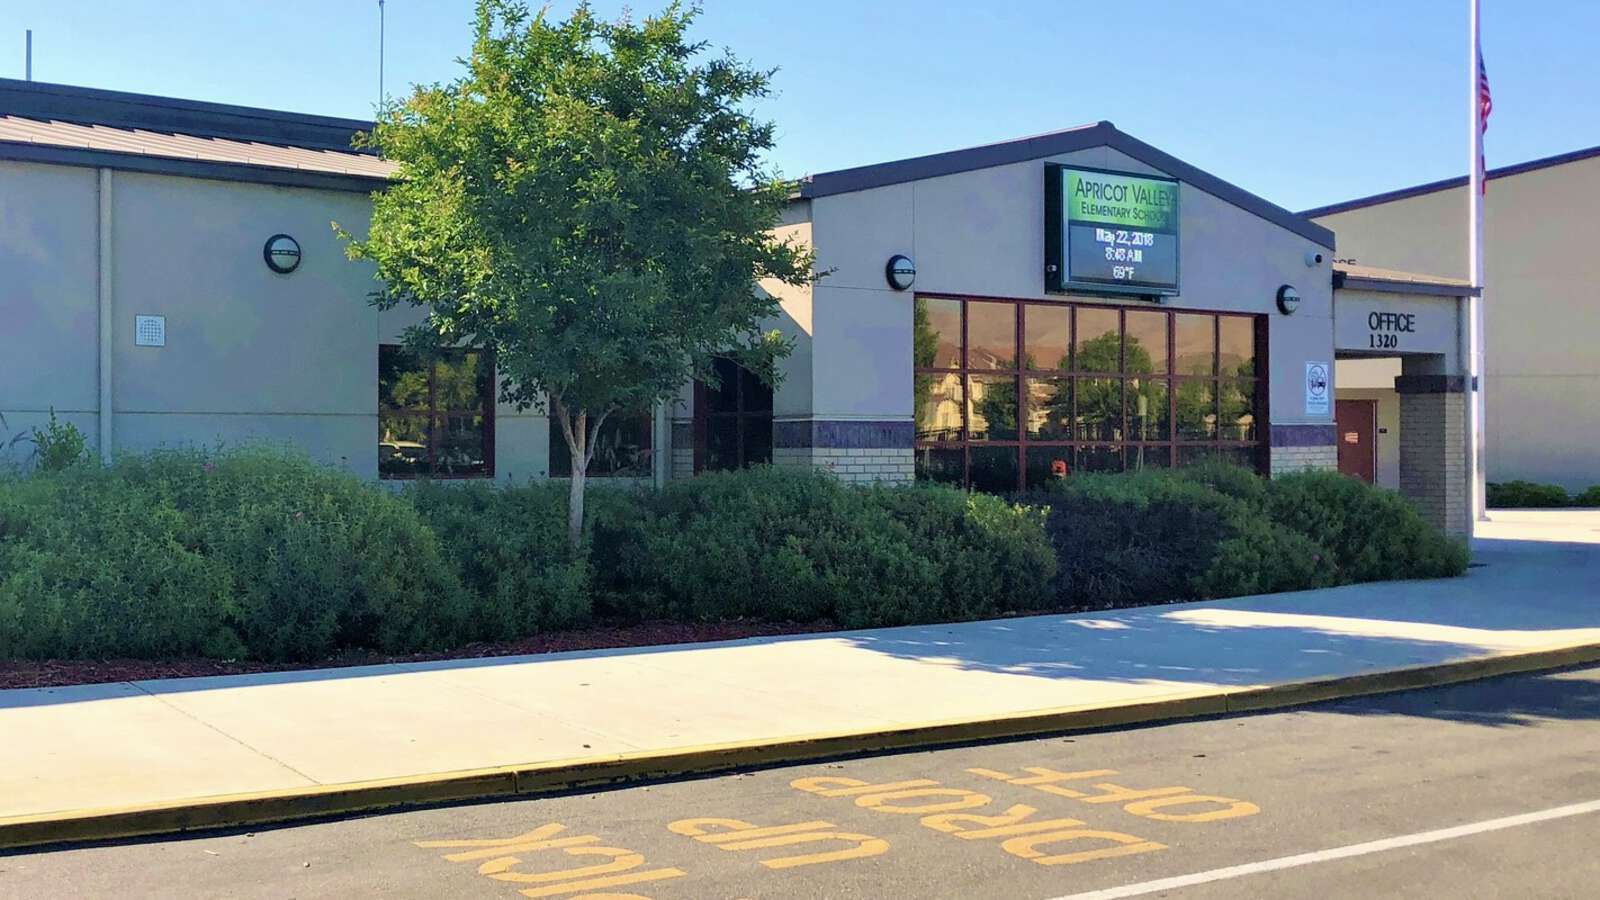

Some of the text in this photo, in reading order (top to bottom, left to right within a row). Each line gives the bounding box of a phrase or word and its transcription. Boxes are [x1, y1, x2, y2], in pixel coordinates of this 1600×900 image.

[1075, 178, 1128, 202] APRICOT
[1081, 201, 1168, 223] ELEMENTARY SCHOO
[1095, 228, 1115, 246] May
[1131, 231, 1154, 246] 2018
[1126, 248, 1142, 262] AM
[1368, 311, 1415, 333] OFFICE
[1369, 334, 1397, 348] 1320
[966, 766, 1261, 822] OFF
[790, 776, 1169, 866] DROP
[667, 818, 891, 869] UP
[412, 822, 688, 900] ICK
